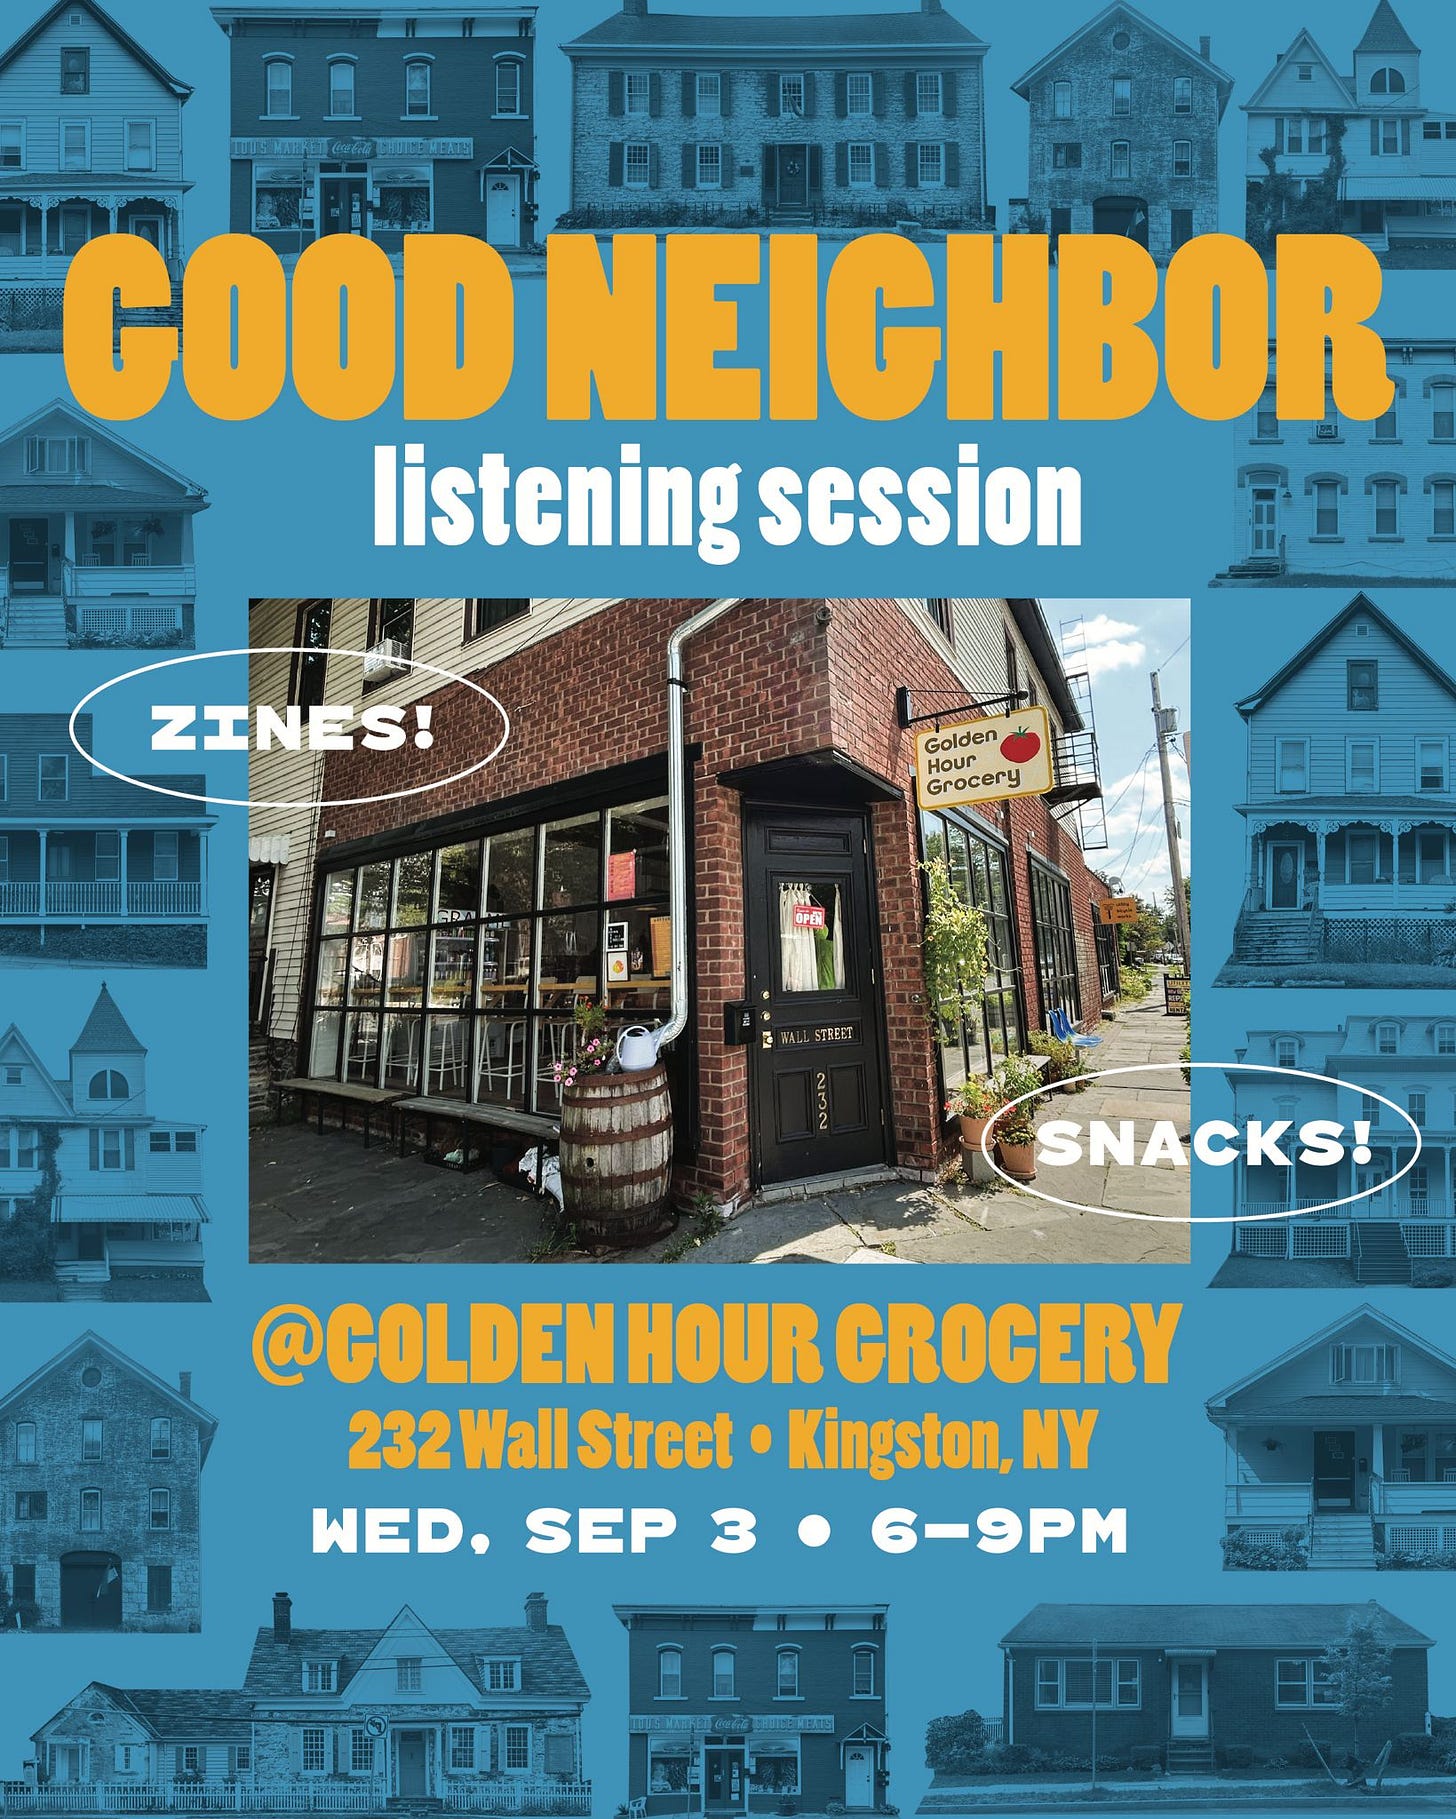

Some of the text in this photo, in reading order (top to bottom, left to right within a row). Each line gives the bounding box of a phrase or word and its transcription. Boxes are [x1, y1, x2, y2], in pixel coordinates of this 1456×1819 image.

[274, 141, 324, 155] MARKET
[379, 141, 470, 155] CHOICE MEATS
[63, 233, 1396, 421] GOOD NEIGHBOR
[374, 443, 1082, 566] listening session
[151, 704, 434, 751] ZINES!
[924, 729, 998, 755] Golden
[926, 768, 1021, 796] Grocery
[927, 754, 977, 775] Hour
[795, 911, 823, 926] OPEN
[780, 1026, 854, 1045] WALL STREET
[816, 1072, 828, 1130] 232
[1037, 1119, 1373, 1167] SNACKS!
[252, 1303, 1183, 1386] @GOLDEN HOUR GROCERY
[349, 1410, 451, 1469] 232
[459, 1408, 569, 1469] Wall
[577, 1409, 734, 1469] Street
[789, 1407, 1013, 1481] Kingston,
[1023, 1409, 1099, 1469] NY
[313, 1508, 490, 1555] WED,
[526, 1507, 677, 1553] SEP
[711, 1508, 757, 1553] 3
[797, 1718, 832, 1730] MEATS
